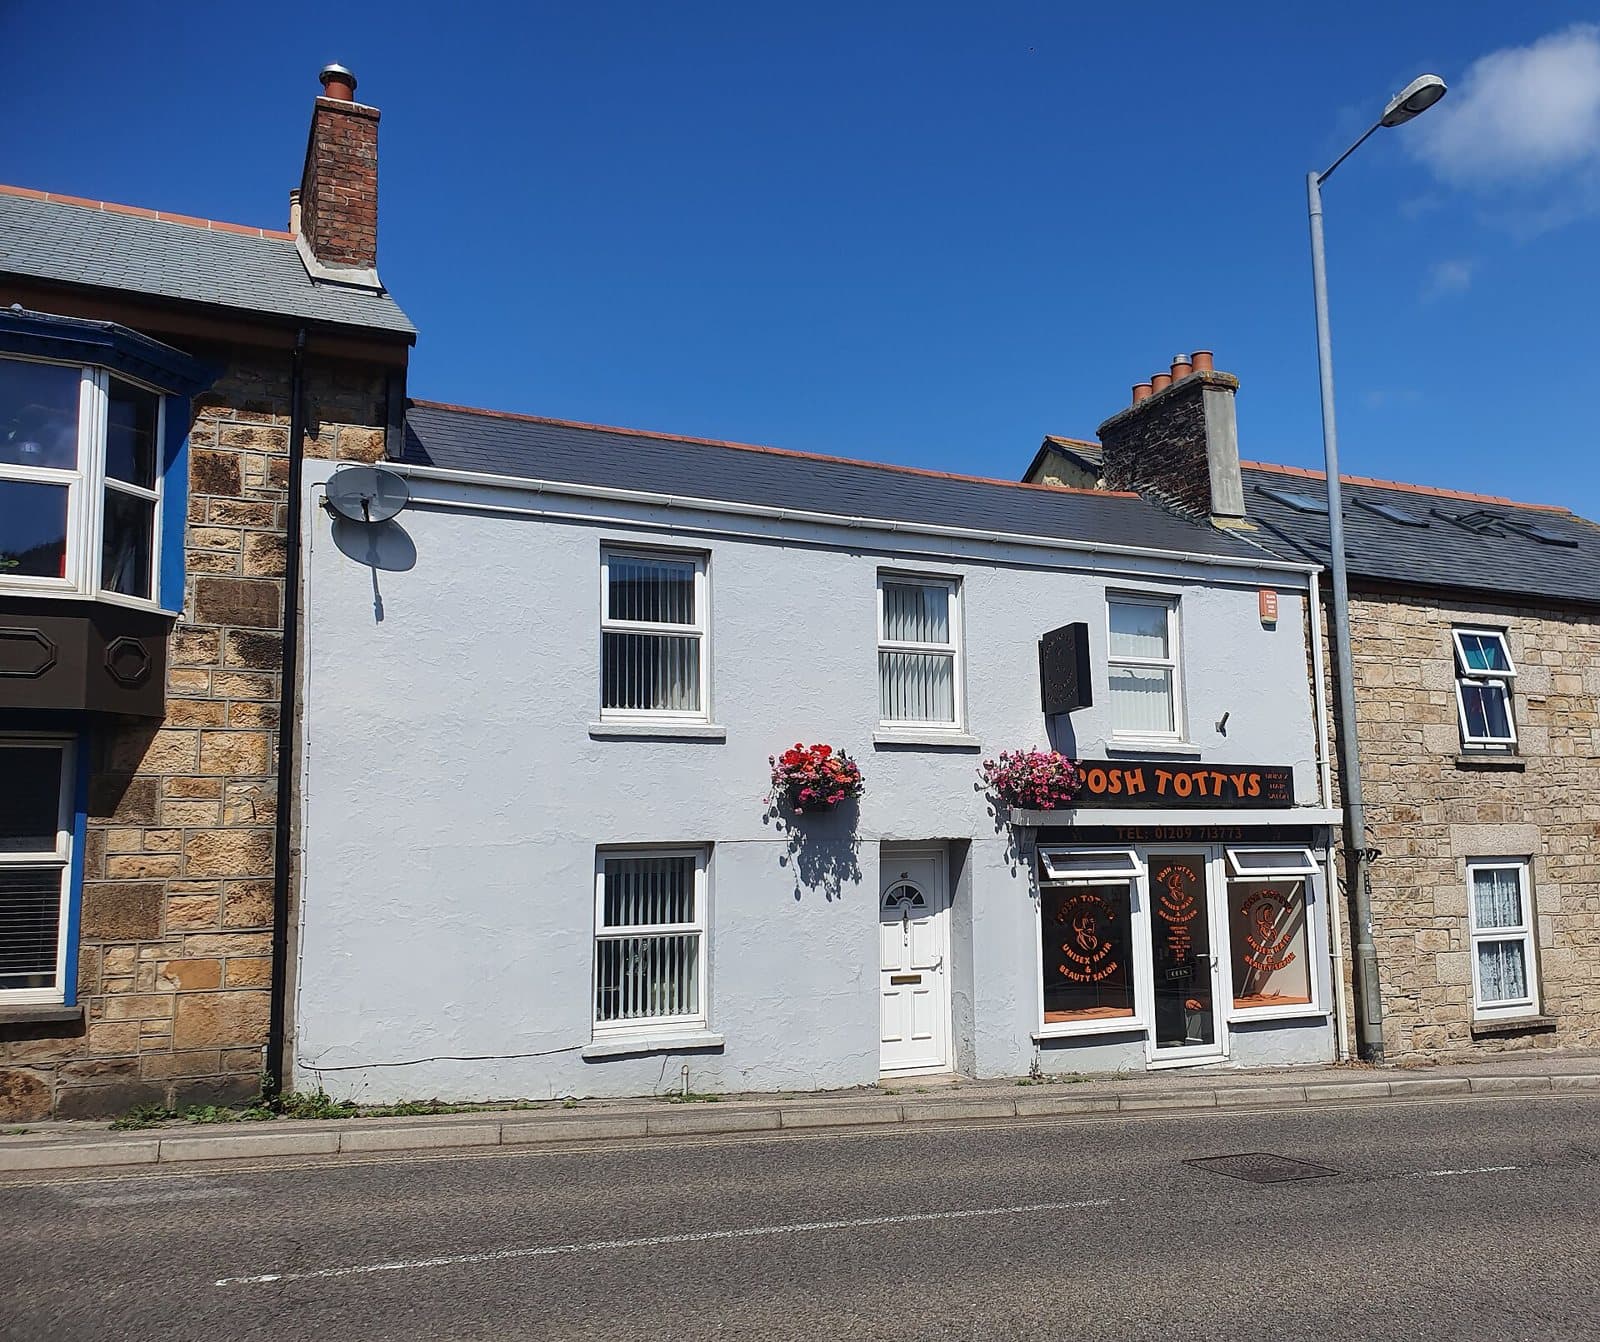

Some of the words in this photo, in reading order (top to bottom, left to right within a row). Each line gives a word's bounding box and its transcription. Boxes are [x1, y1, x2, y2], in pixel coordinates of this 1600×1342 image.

[1154, 769, 1261, 797] TOTTYS
[1117, 829, 1149, 840] TEL:
[1154, 829, 1192, 840] 01209
[1062, 943, 1090, 965] UNISEX
[1092, 941, 1113, 962] HAIR
[1273, 934, 1291, 954] HAIR
[1059, 964, 1090, 982] BEAUTY
[1091, 961, 1118, 981] SALON
